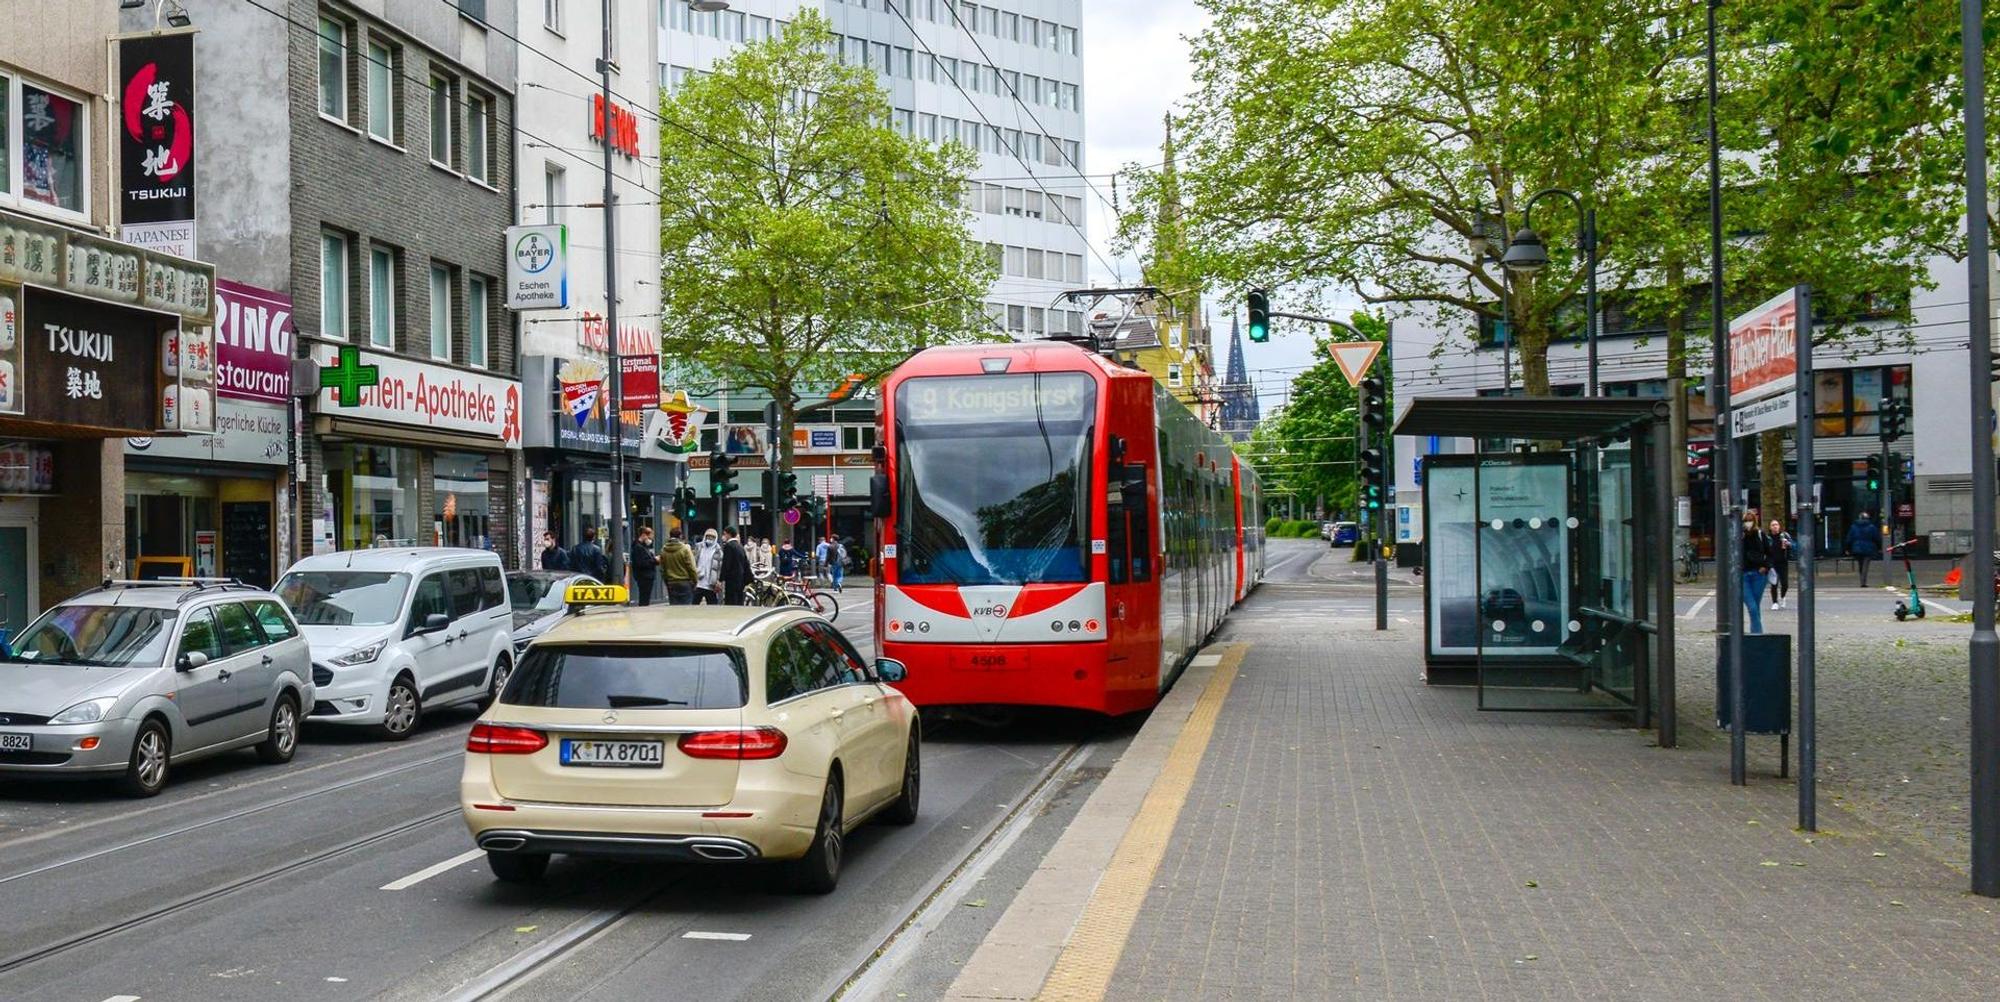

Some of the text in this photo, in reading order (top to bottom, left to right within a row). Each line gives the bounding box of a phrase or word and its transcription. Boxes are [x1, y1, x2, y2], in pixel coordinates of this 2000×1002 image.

[129, 187, 186, 200] TSUKIJI
[127, 229, 189, 243] JAPANESE
[518, 248, 550, 258] BAYER
[519, 281, 550, 290] Eschen
[515, 292, 555, 302] Apotheke
[44, 323, 113, 362] TSUKIJI
[623, 357, 652, 366] Erstmal
[633, 364, 658, 373] Penny
[67, 367, 102, 399] 築地
[217, 361, 289, 395] staurant
[565, 383, 587, 393] GOLDEN
[577, 385, 599, 395] POTATO
[947, 380, 1079, 414] Königsforst
[257, 415, 282, 435] Küche
[574, 588, 614, 600] TAXI
[973, 607, 993, 616] KVB
[2, 735, 28, 748] 8824
[571, 743, 660, 762] K TX 8701
